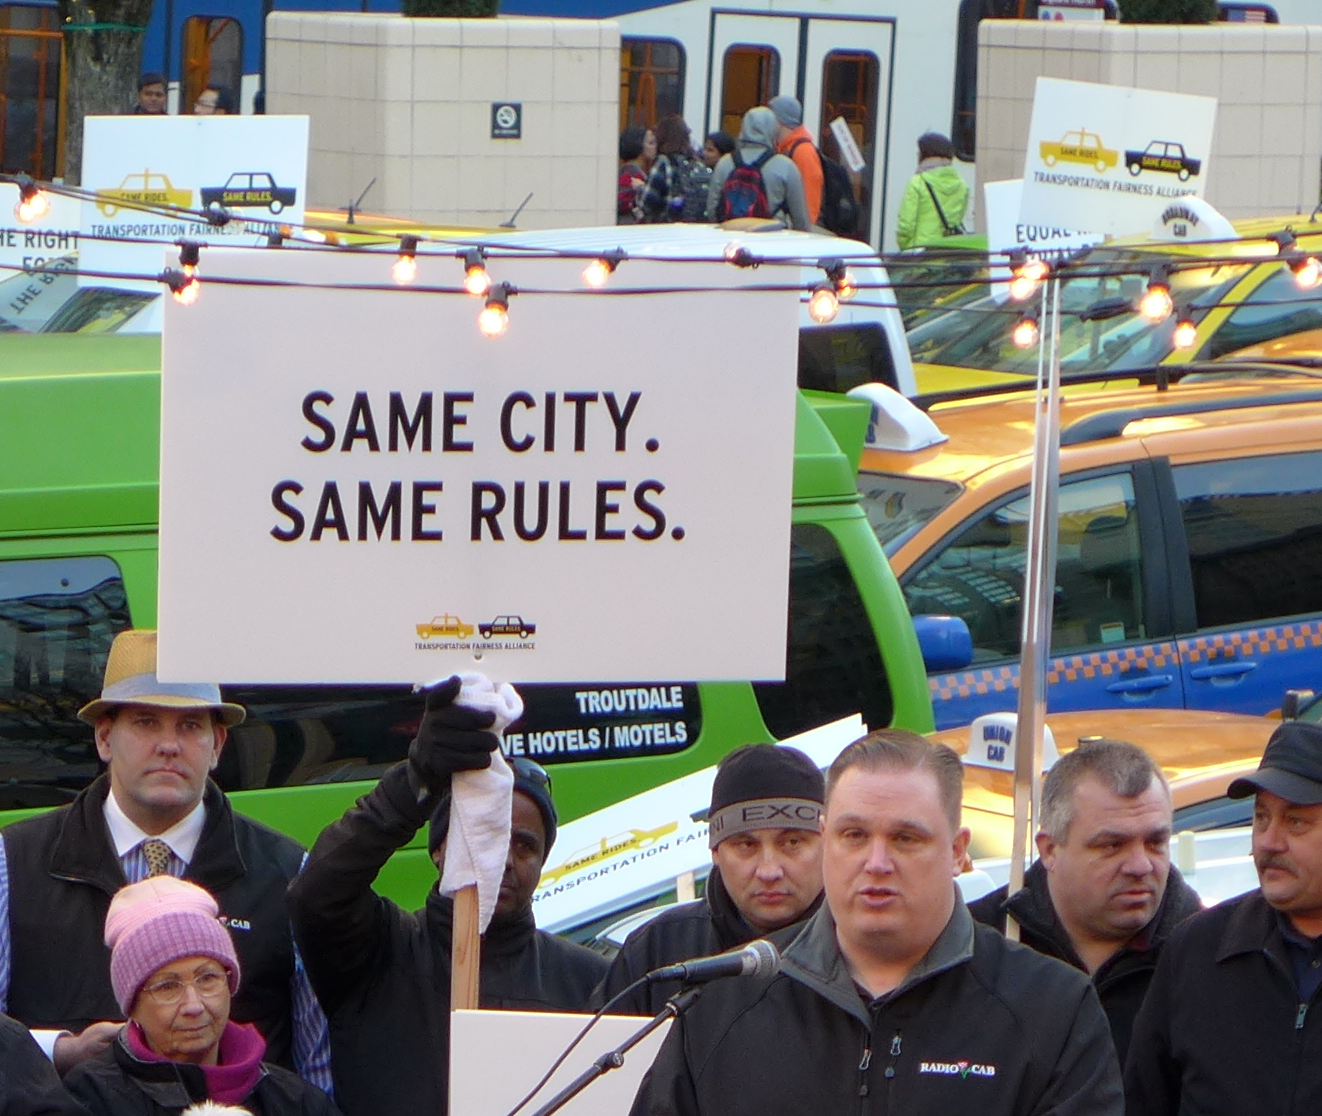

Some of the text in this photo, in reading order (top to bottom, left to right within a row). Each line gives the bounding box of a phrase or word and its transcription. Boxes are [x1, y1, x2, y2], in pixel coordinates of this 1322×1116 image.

[1033, 171, 1110, 191] TRANSPORTATION
[1111, 181, 1154, 196] FAIRNESS
[24, 228, 80, 250] RIGHT
[91, 224, 186, 238] TRANSPORTATION
[299, 389, 661, 453] SAME CITY.
[269, 478, 686, 543] SAME RULES.
[575, 685, 684, 714] TROUTDALE
[502, 721, 688, 756] VE HOTELS / MOTELS
[982, 724, 1013, 747] UNION
[986, 743, 1006, 763] CAB
[564, 837, 643, 872] SAME RIDES.
[532, 842, 670, 904] RANSPORTATION
[230, 918, 251, 931] CAB
[919, 1061, 996, 1076] RADIO CAB
